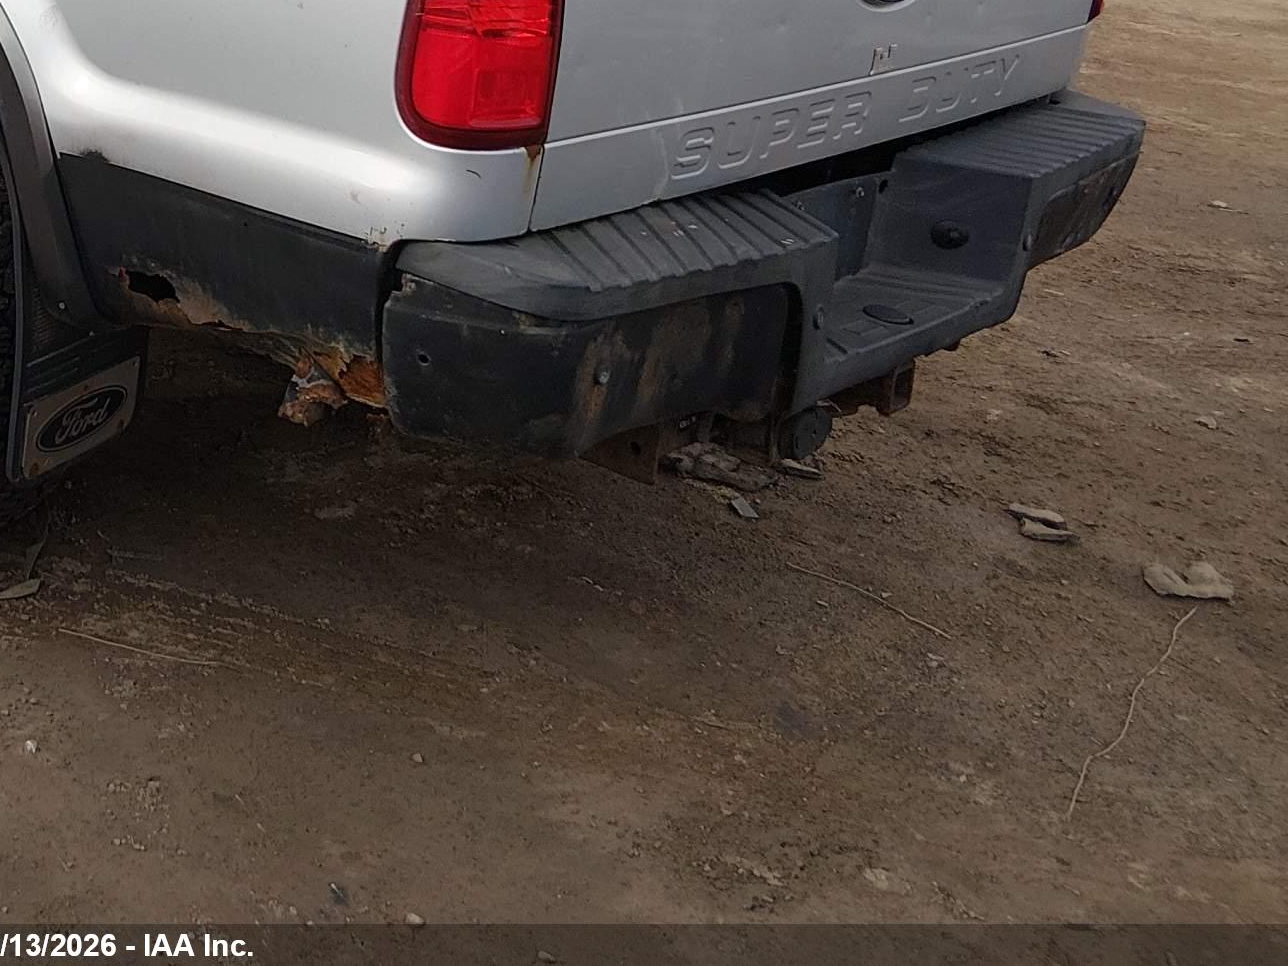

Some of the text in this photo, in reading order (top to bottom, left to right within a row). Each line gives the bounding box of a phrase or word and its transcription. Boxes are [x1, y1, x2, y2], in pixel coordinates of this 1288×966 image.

[670, 54, 1021, 181] SUPER DUTY
[54, 396, 111, 445] Ford
